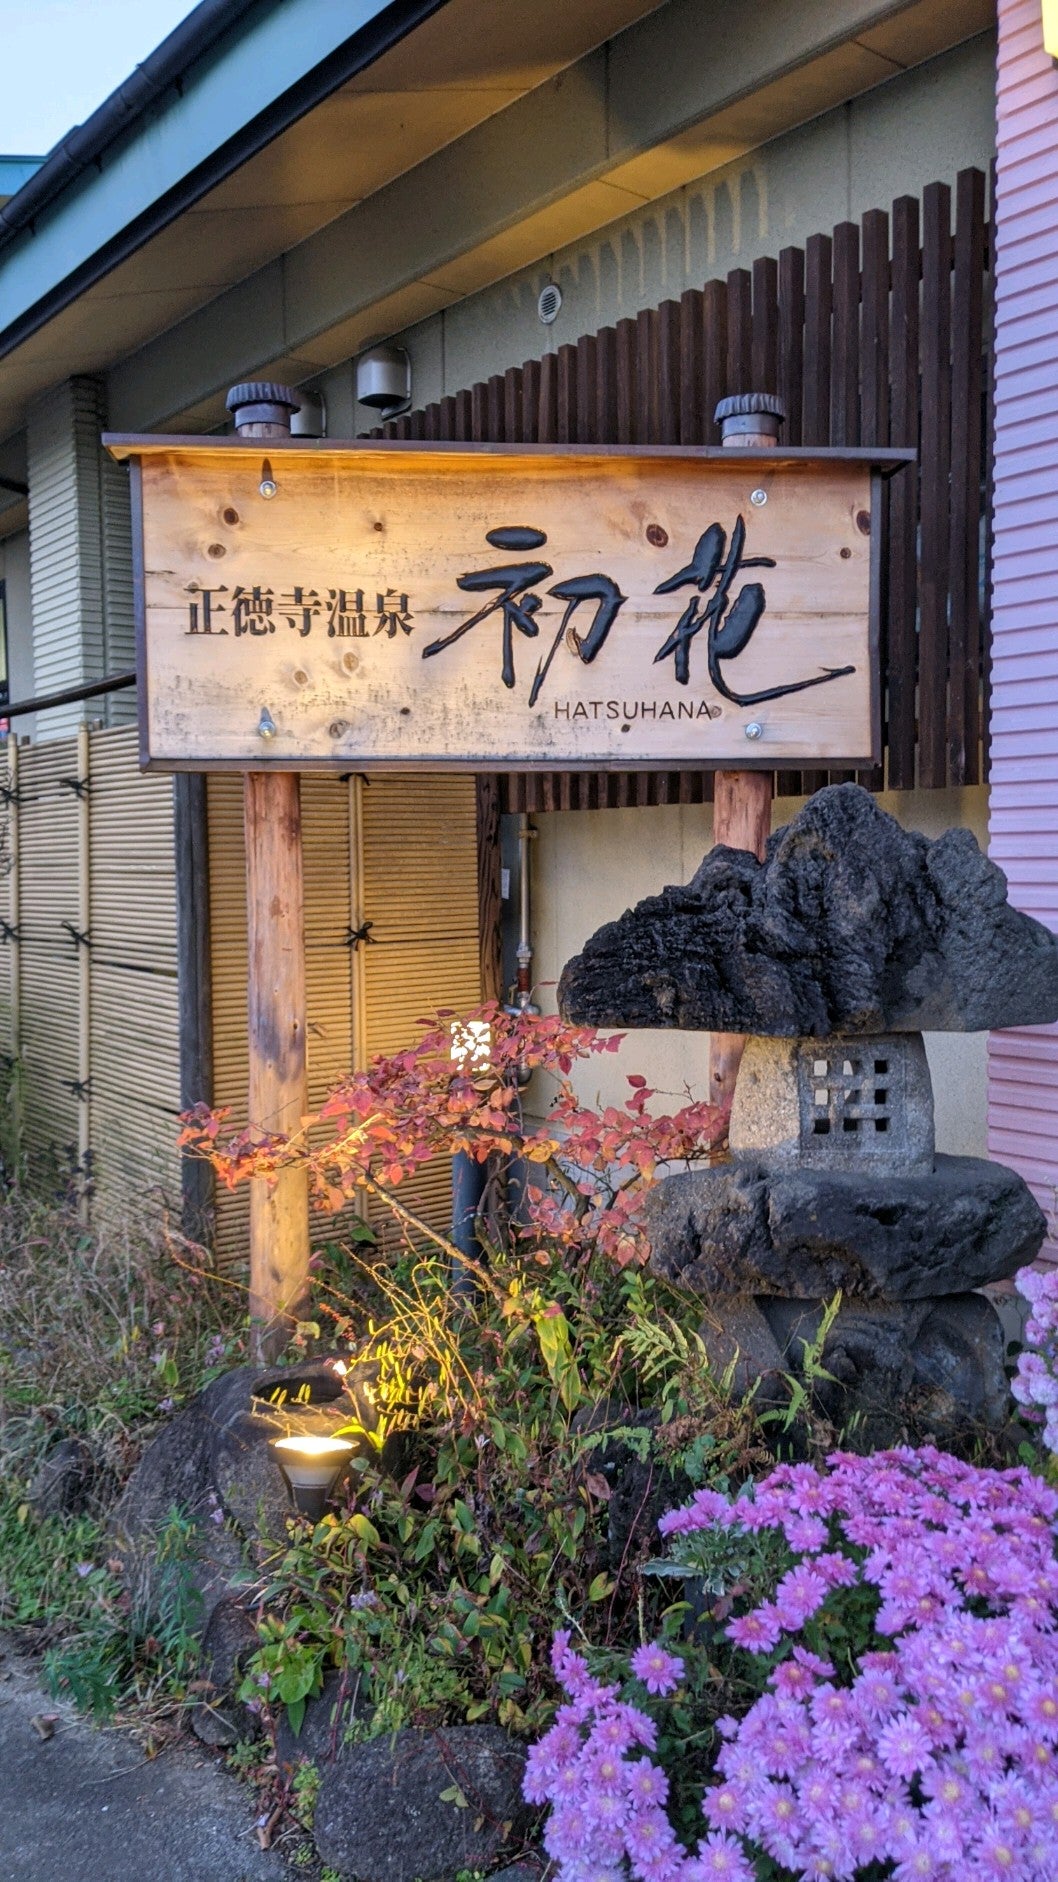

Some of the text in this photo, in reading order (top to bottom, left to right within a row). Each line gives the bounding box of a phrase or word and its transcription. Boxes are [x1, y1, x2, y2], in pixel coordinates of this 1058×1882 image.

[184, 585, 415, 639] 正徳寺温泉
[422, 513, 857, 707] 初花
[554, 700, 712, 720] HATSUHANA
